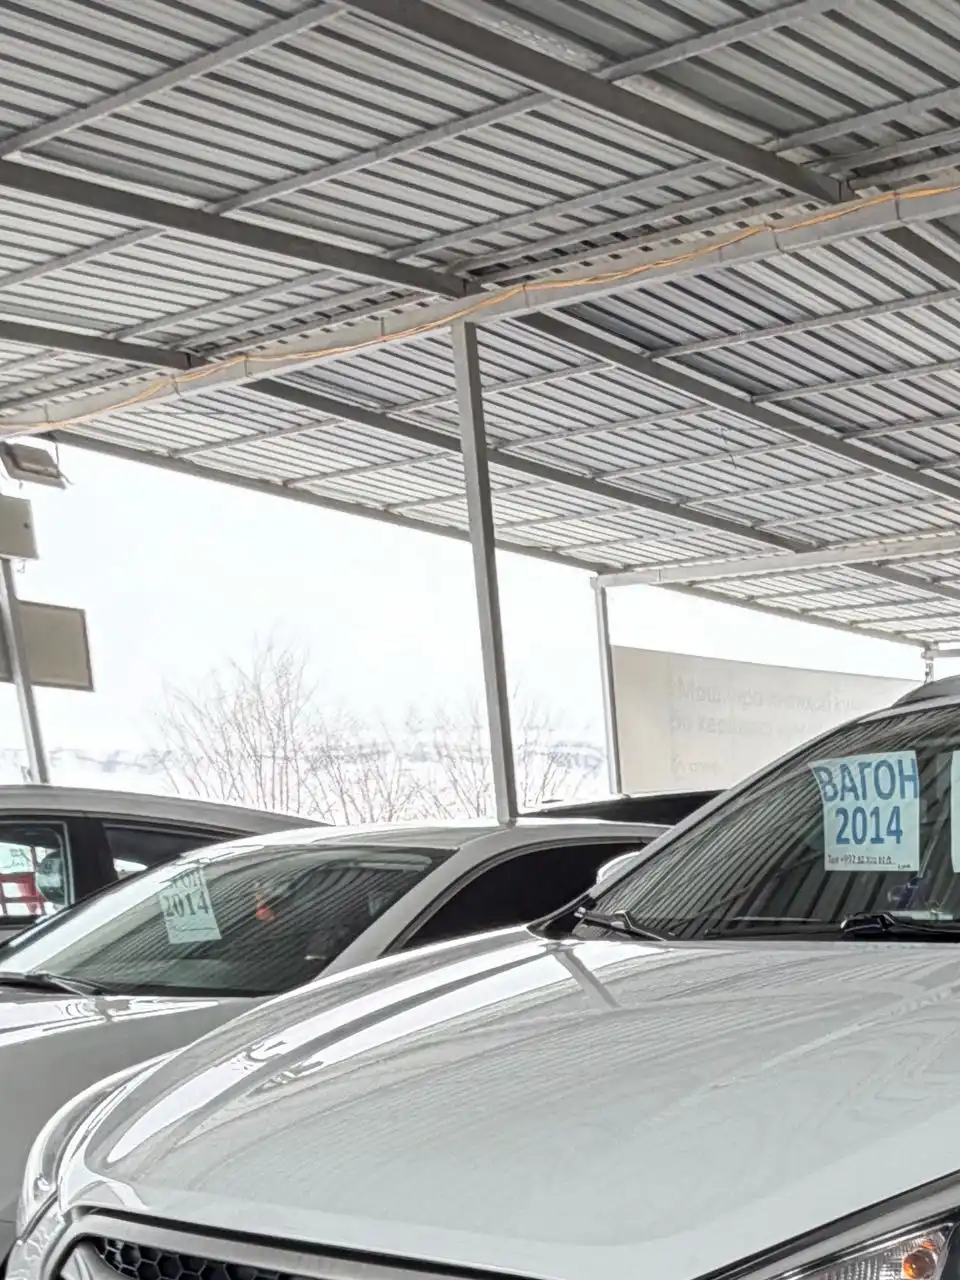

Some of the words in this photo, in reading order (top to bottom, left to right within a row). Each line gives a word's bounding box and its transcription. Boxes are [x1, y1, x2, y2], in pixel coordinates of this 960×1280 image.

[814, 758, 919, 802] ВАГОН
[835, 806, 903, 845] 2014
[162, 891, 209, 917] 2014
